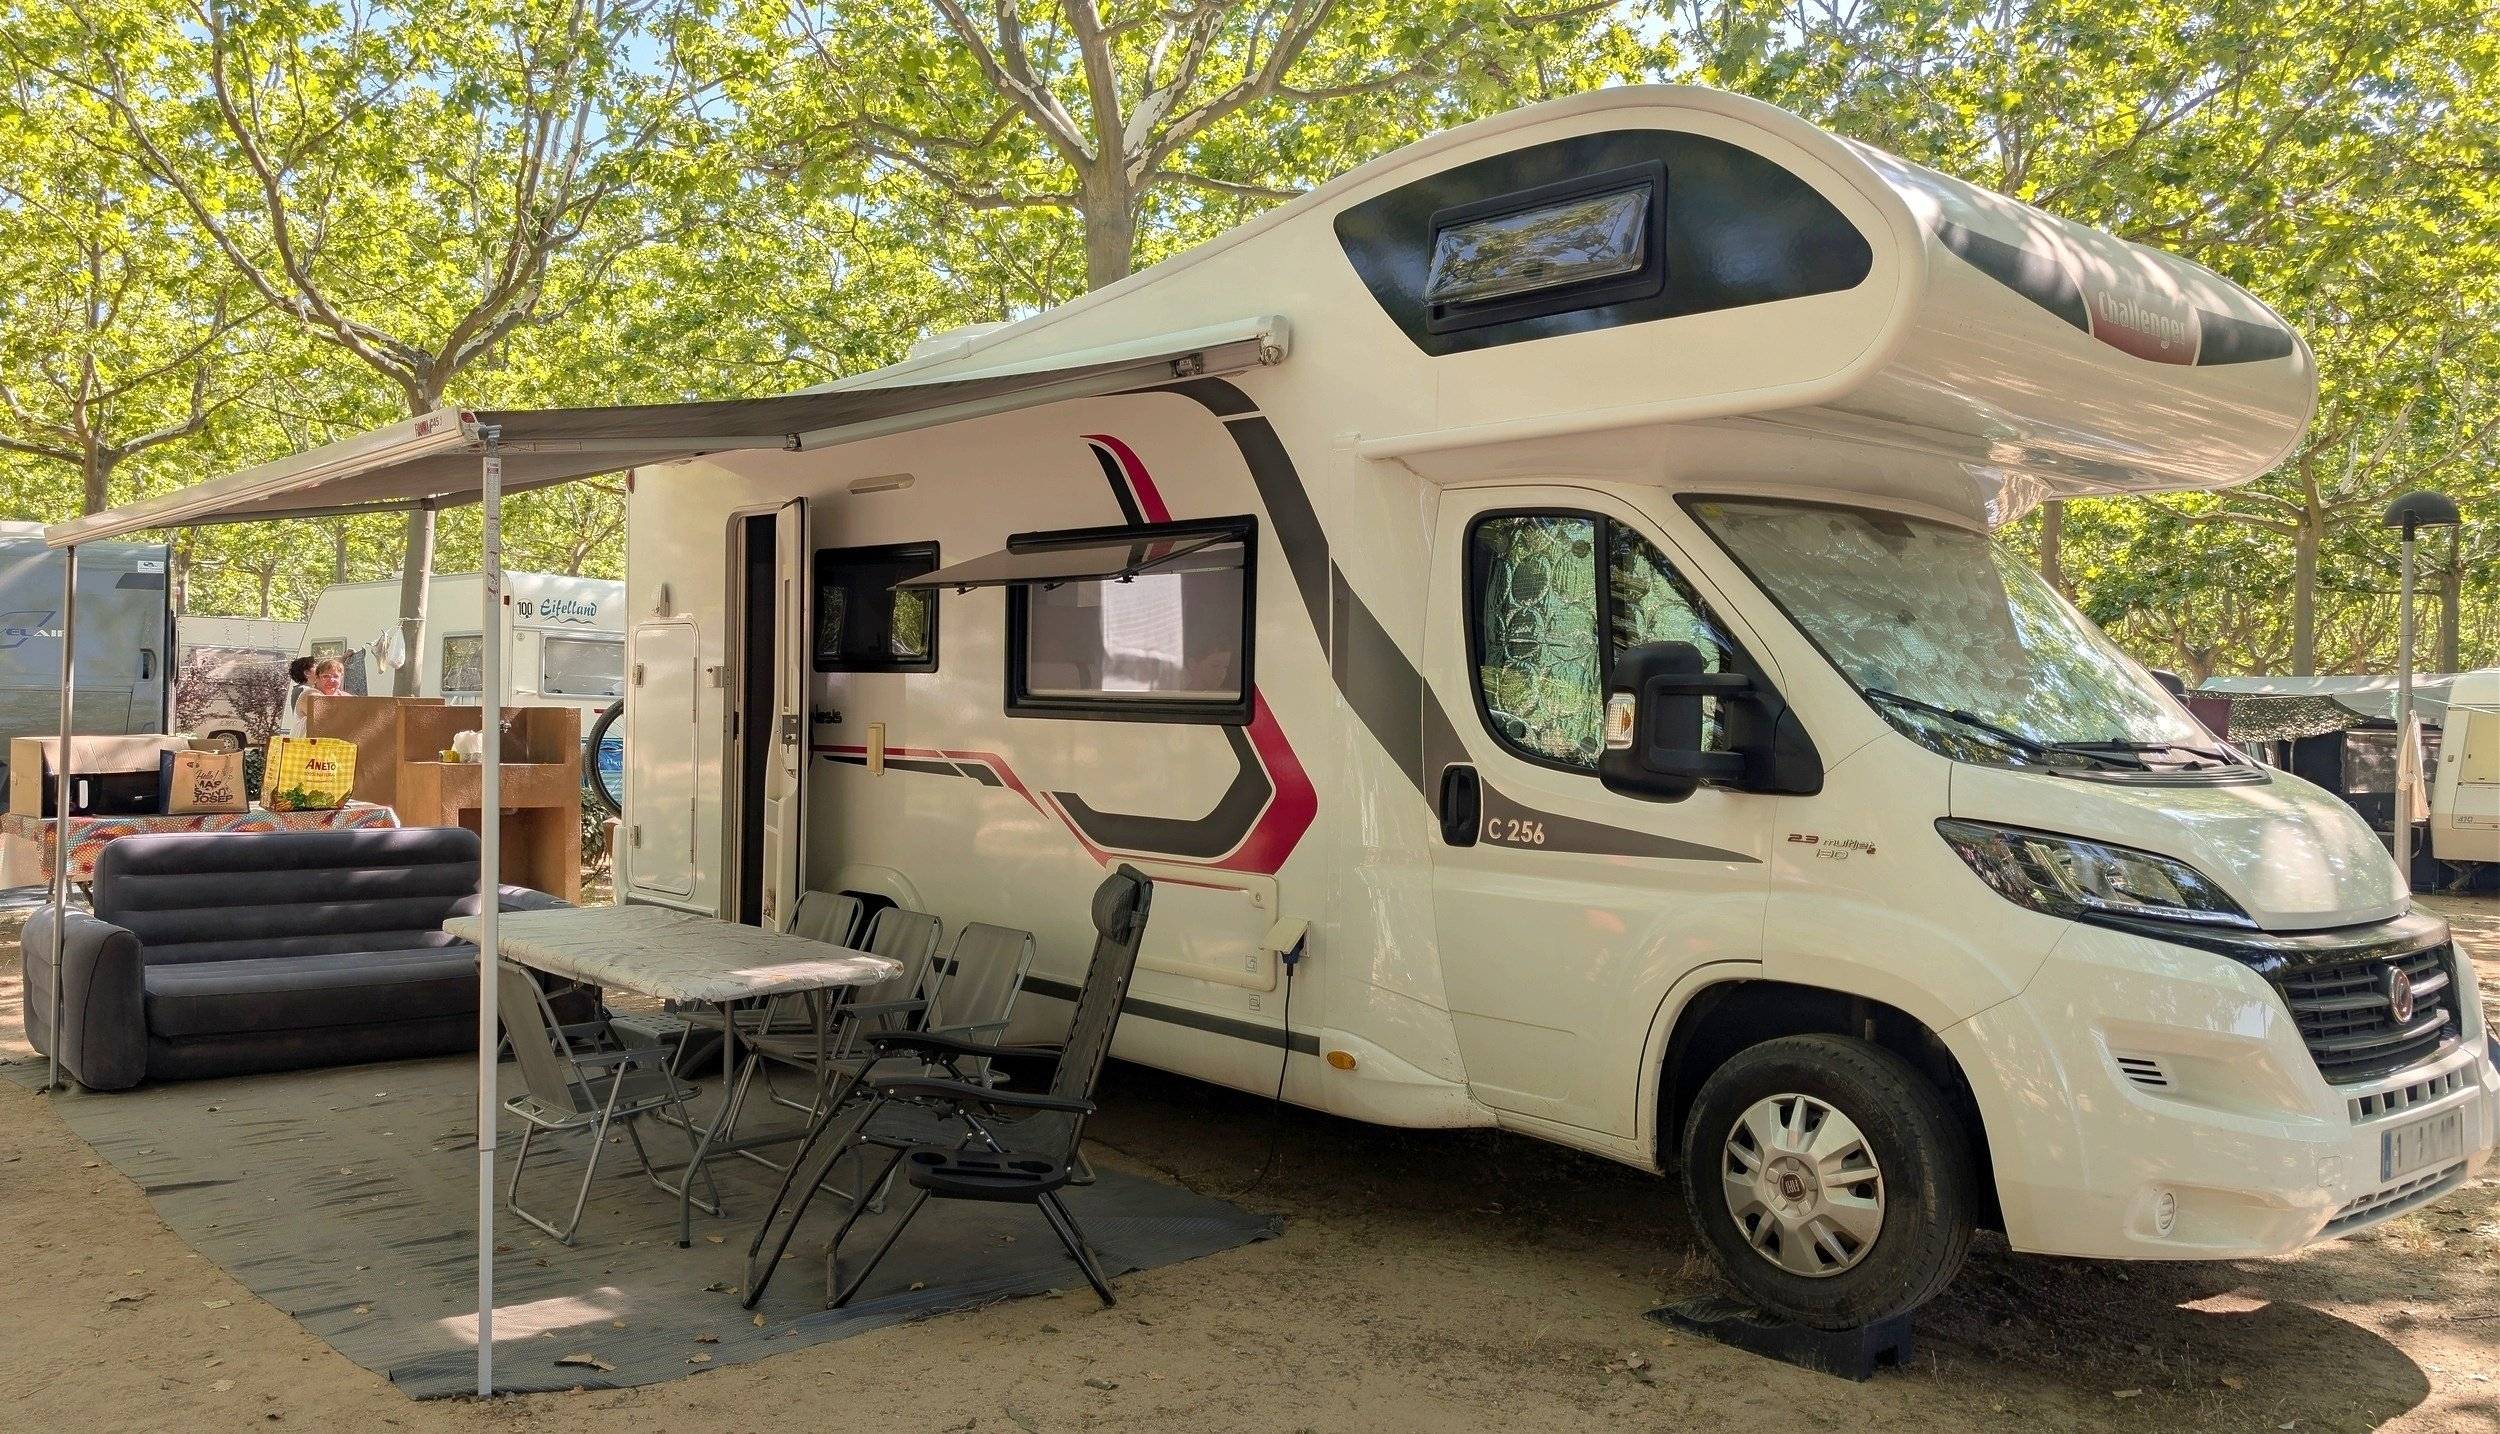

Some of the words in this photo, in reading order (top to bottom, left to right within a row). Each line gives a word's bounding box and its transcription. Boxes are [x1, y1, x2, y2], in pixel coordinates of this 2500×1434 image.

[2098, 290, 2185, 349] Challenger
[517, 601, 533, 616] 100
[540, 598, 597, 617] Eifelland
[305, 758, 337, 771] ANETO
[193, 794, 234, 804] JOSEP
[1488, 817, 1502, 840] C
[1507, 819, 1545, 845] 256
